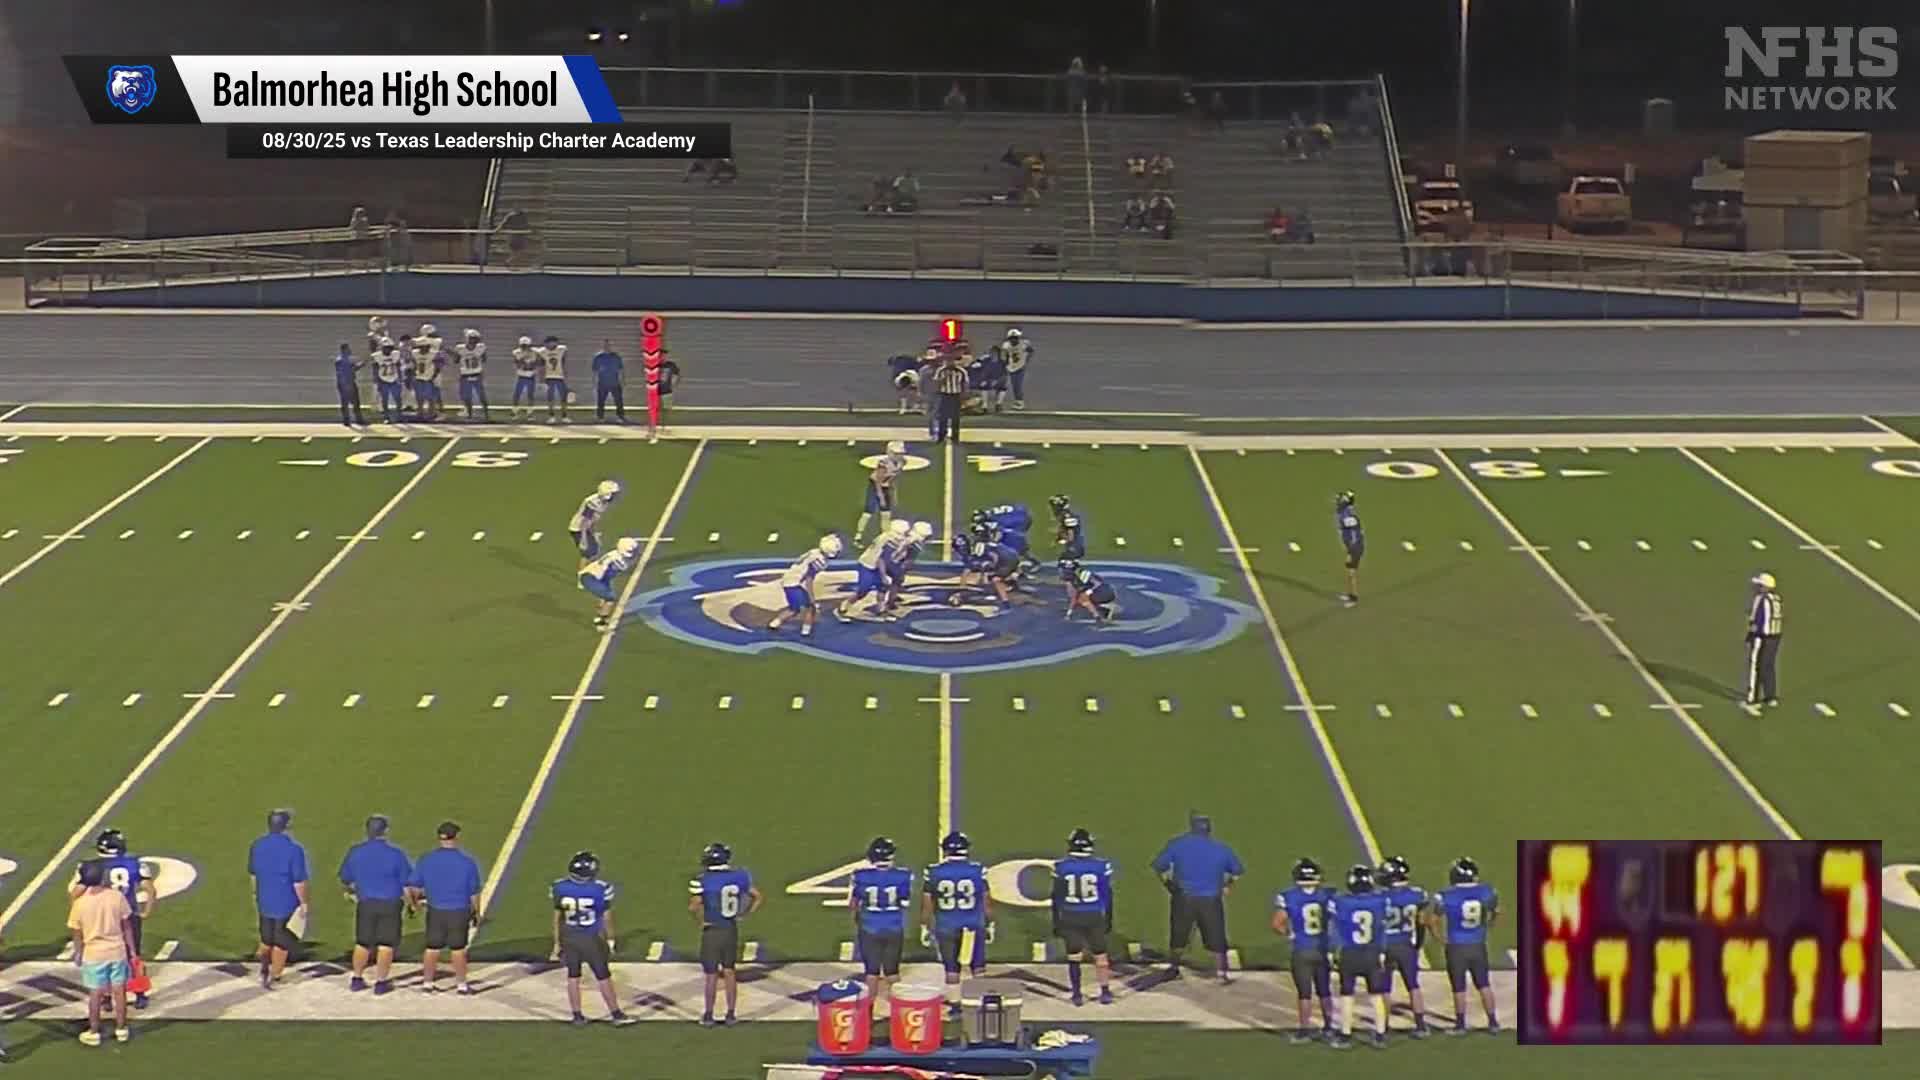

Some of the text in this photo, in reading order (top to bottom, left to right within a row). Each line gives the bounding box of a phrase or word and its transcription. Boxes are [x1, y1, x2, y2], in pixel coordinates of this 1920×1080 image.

[945, 320, 955, 340] 1
[721, 884, 740, 918] 6
[866, 886, 899, 912] 11
[937, 879, 976, 910] 33
[1065, 874, 1099, 904] 16
[560, 897, 596, 926] 25
[1461, 899, 1482, 928] 9
[1352, 910, 1373, 944] 3
[835, 1010, 854, 1025] G
[907, 1010, 924, 1025] G
